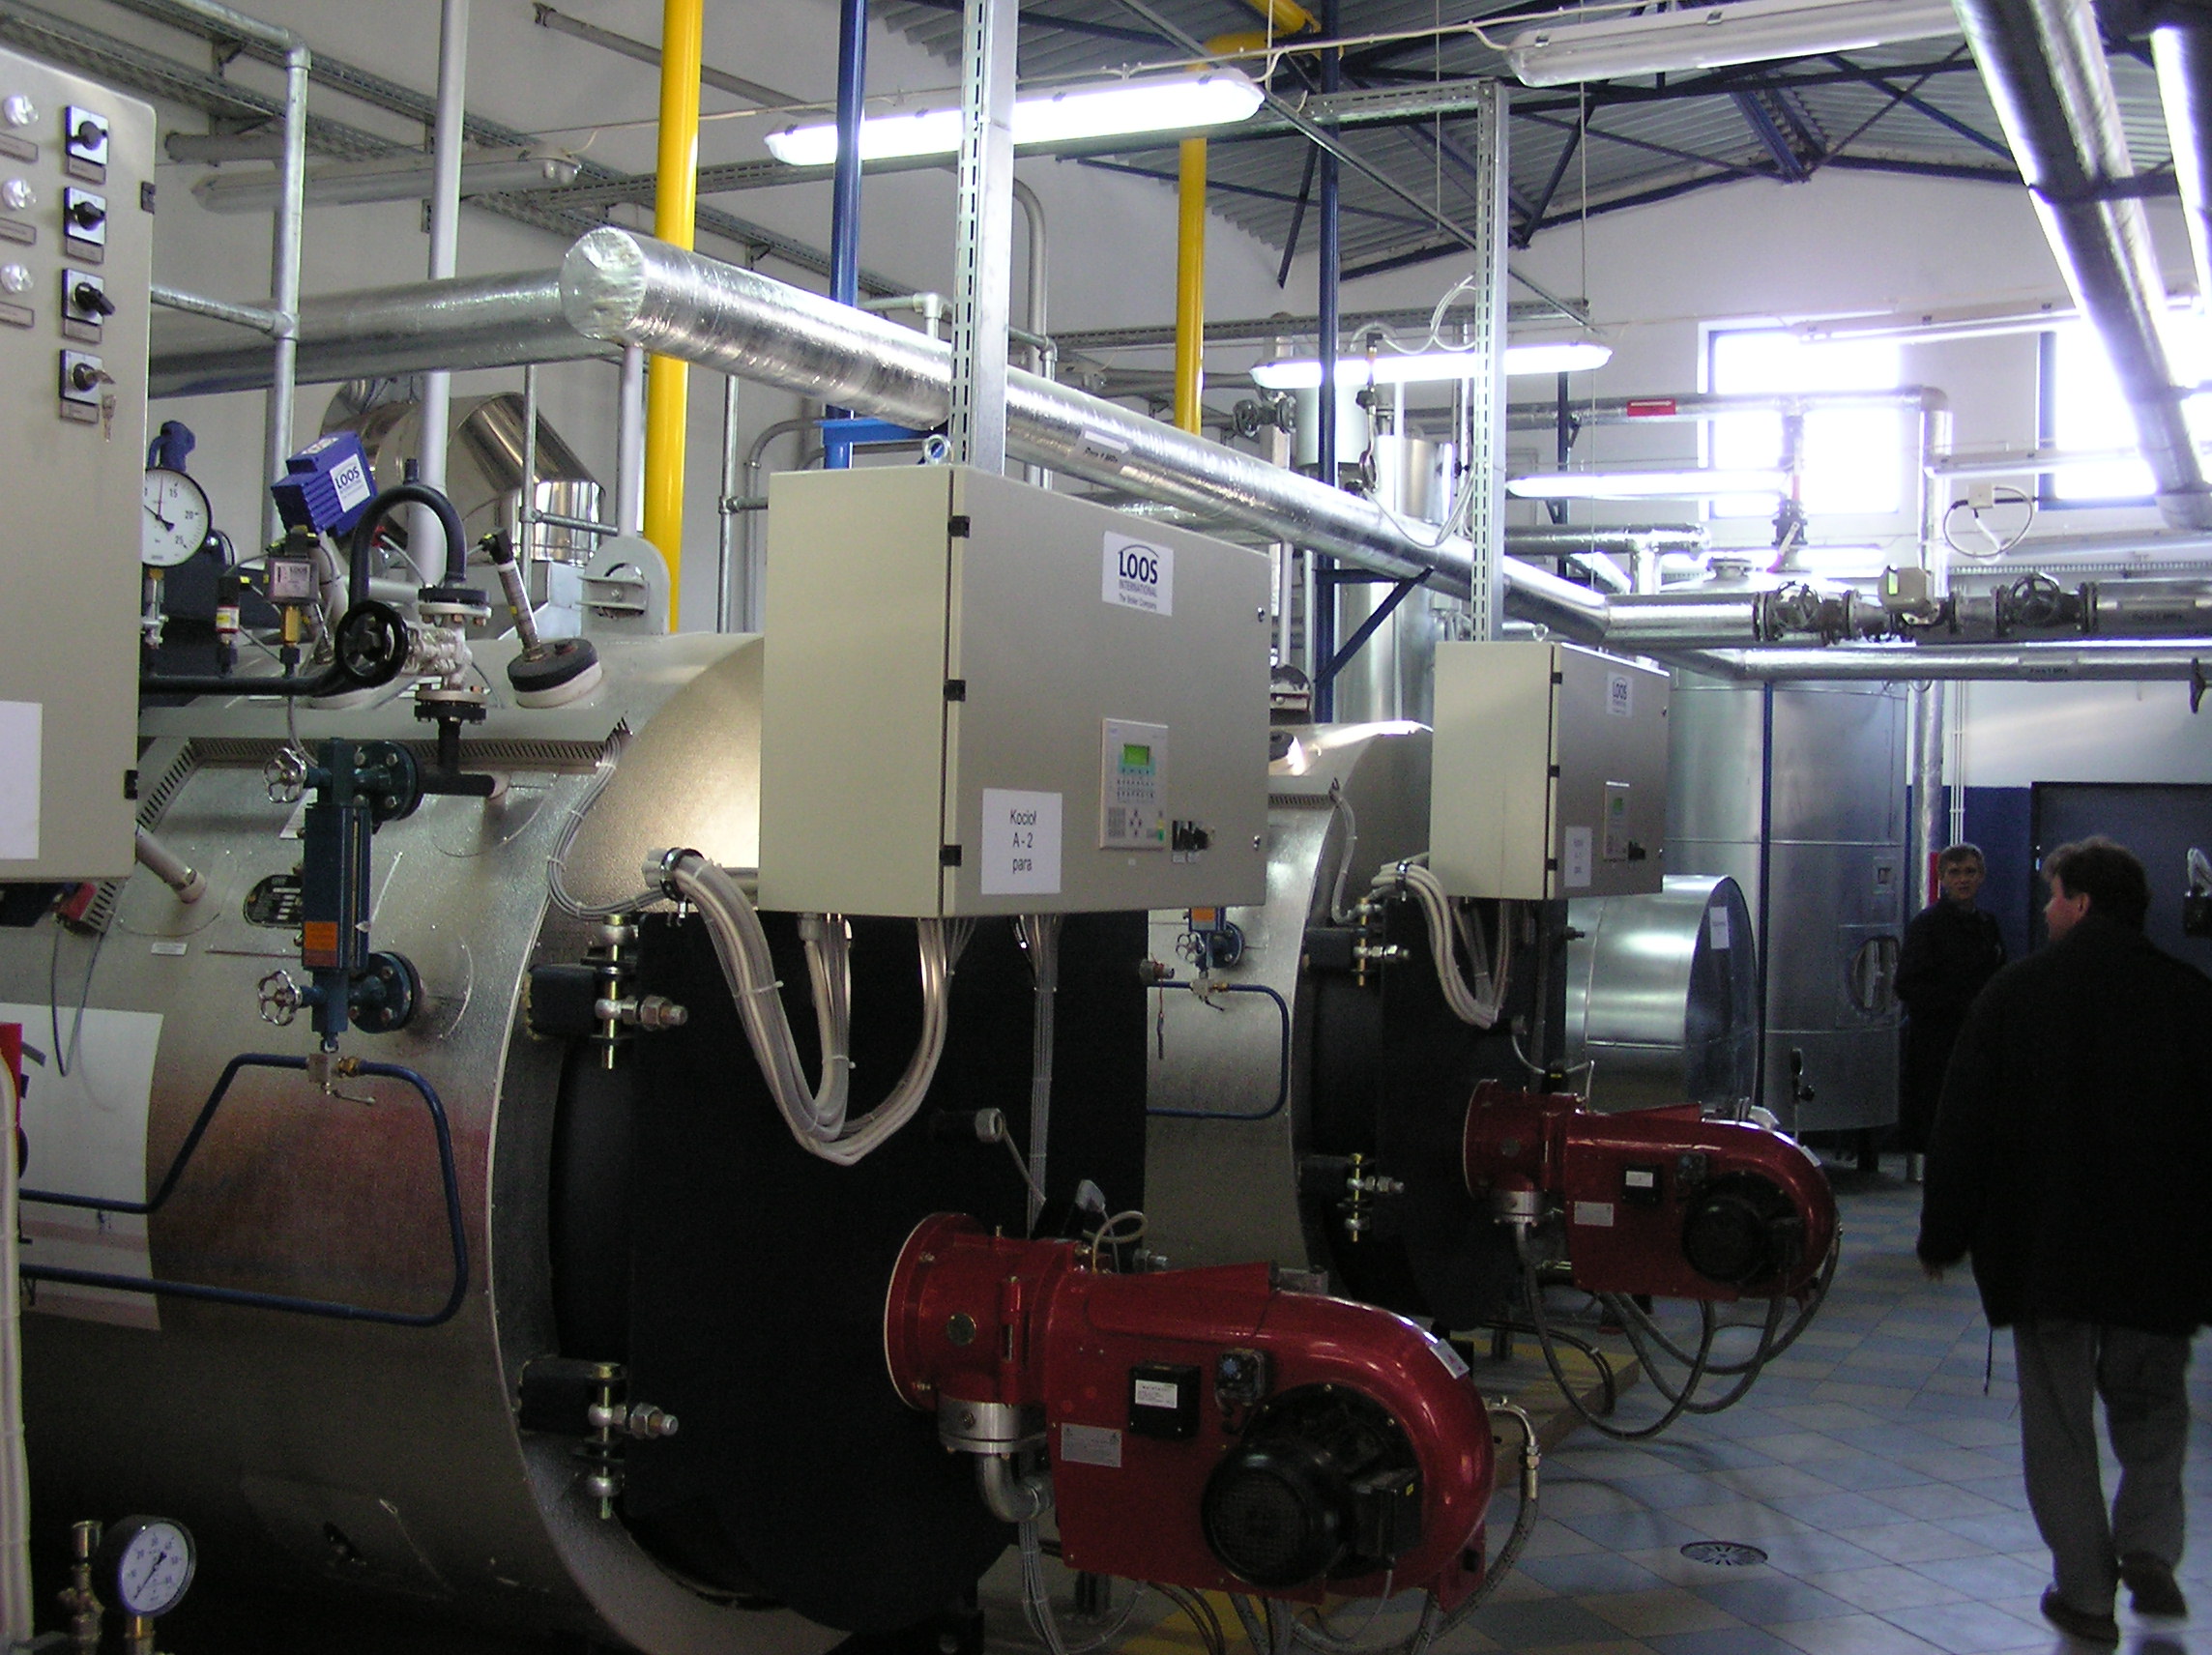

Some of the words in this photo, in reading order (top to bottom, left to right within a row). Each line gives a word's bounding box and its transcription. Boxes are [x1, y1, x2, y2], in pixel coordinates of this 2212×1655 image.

[335, 466, 361, 489] LOOS
[169, 488, 179, 498] 15
[185, 509, 194, 520] 20
[1119, 550, 1158, 585] LOOS
[1012, 858, 1033, 875] para
